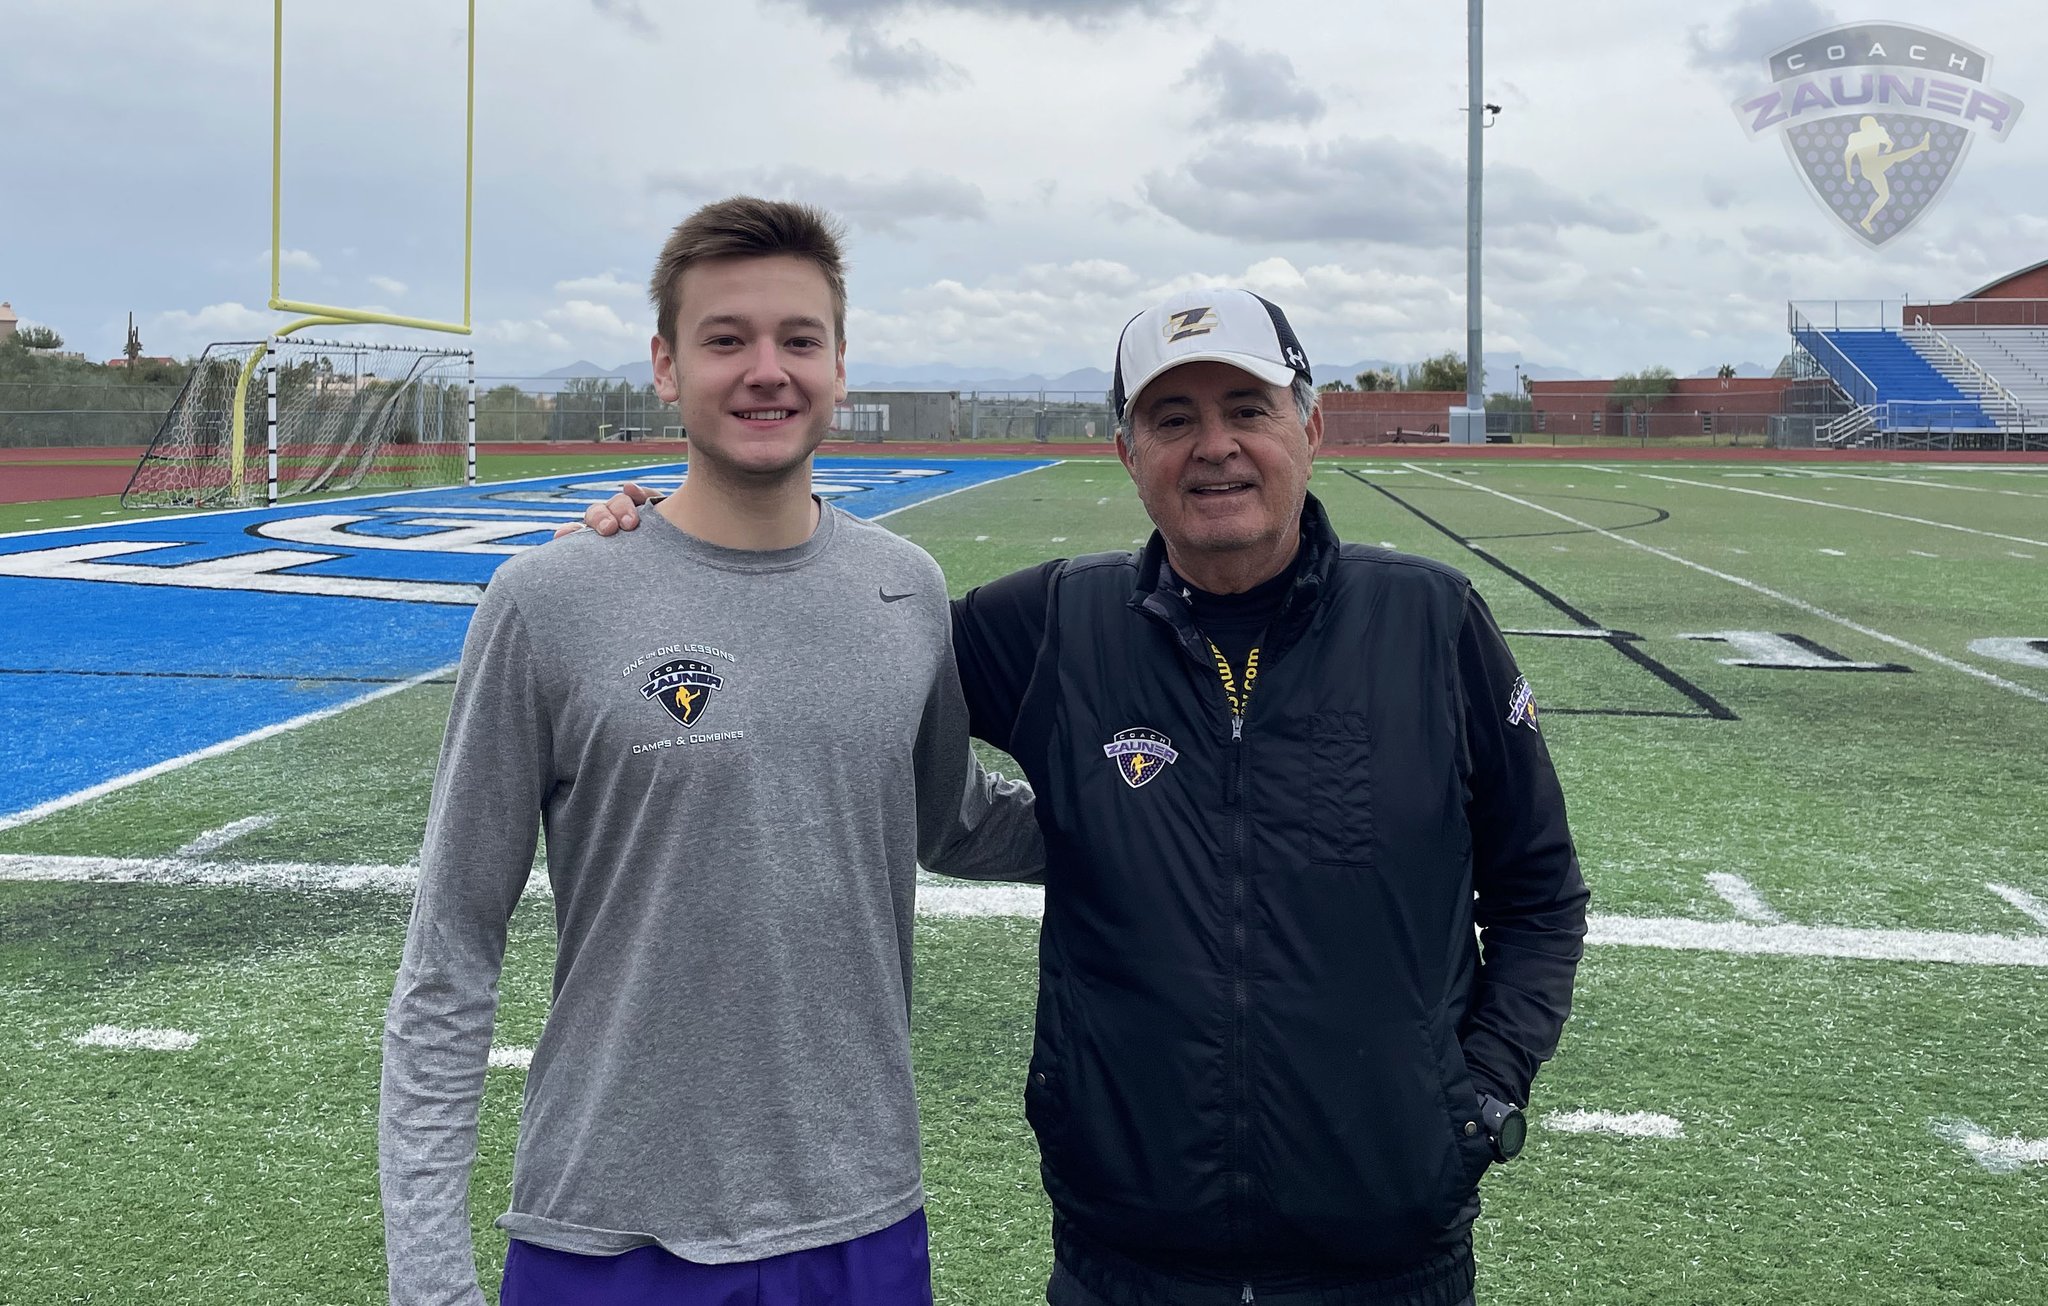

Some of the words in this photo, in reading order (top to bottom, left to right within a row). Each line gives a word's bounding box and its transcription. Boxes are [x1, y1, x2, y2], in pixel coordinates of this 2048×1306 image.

[622, 656, 645, 678] ONE
[657, 644, 681, 656] ONE
[684, 644, 736, 663] LESSONS
[654, 663, 708, 677] COACH
[642, 672, 721, 698] ZAUNER
[632, 739, 672, 754] CAMPS
[676, 736, 686, 746] &
[689, 730, 744, 744] COMBINES
[1119, 732, 1166, 743] COACH
[1106, 741, 1176, 761] ZAUNER
